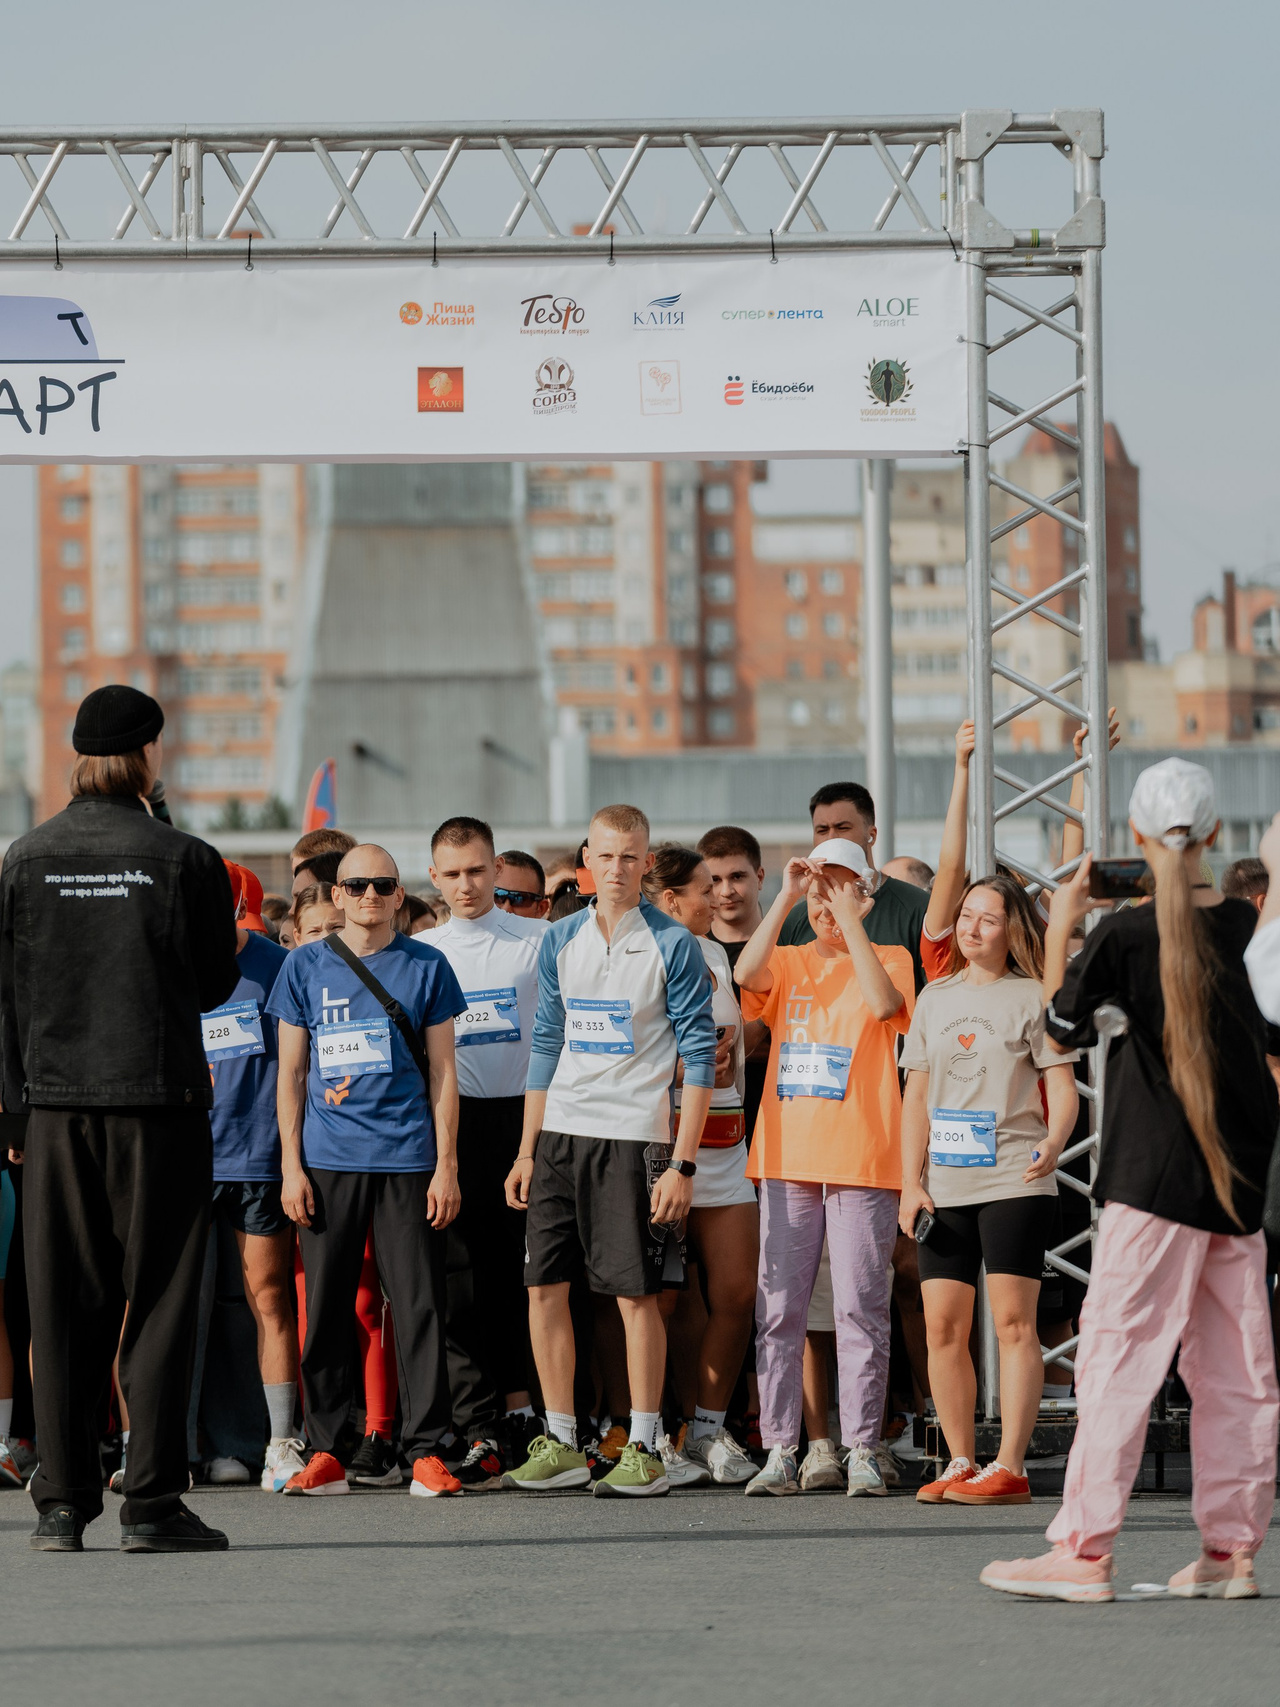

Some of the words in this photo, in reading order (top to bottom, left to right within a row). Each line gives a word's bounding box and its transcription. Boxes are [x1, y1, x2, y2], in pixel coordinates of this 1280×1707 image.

[434, 302, 475, 315] Пища
[857, 298, 919, 317] ALOE
[426, 314, 475, 326] Жизни
[633, 311, 684, 325] КЛИЯ
[873, 318, 906, 327] smart
[751, 380, 814, 395] Ёбидоёби
[420, 399, 462, 409] ЭТАЛОН
[532, 391, 577, 408] СОЮЗ
[860, 408, 889, 416] VOODOO
[890, 408, 917, 416] PEOPLE
[75, 874, 106, 883] только
[465, 1012, 490, 1023] 022
[586, 1021, 605, 1031] 333
[939, 1016, 969, 1036] твори
[970, 1016, 995, 1036] добро
[208, 1027, 230, 1040] 228
[338, 1042, 360, 1054] 344
[797, 1064, 819, 1074] 053
[944, 1132, 964, 1142] 001
